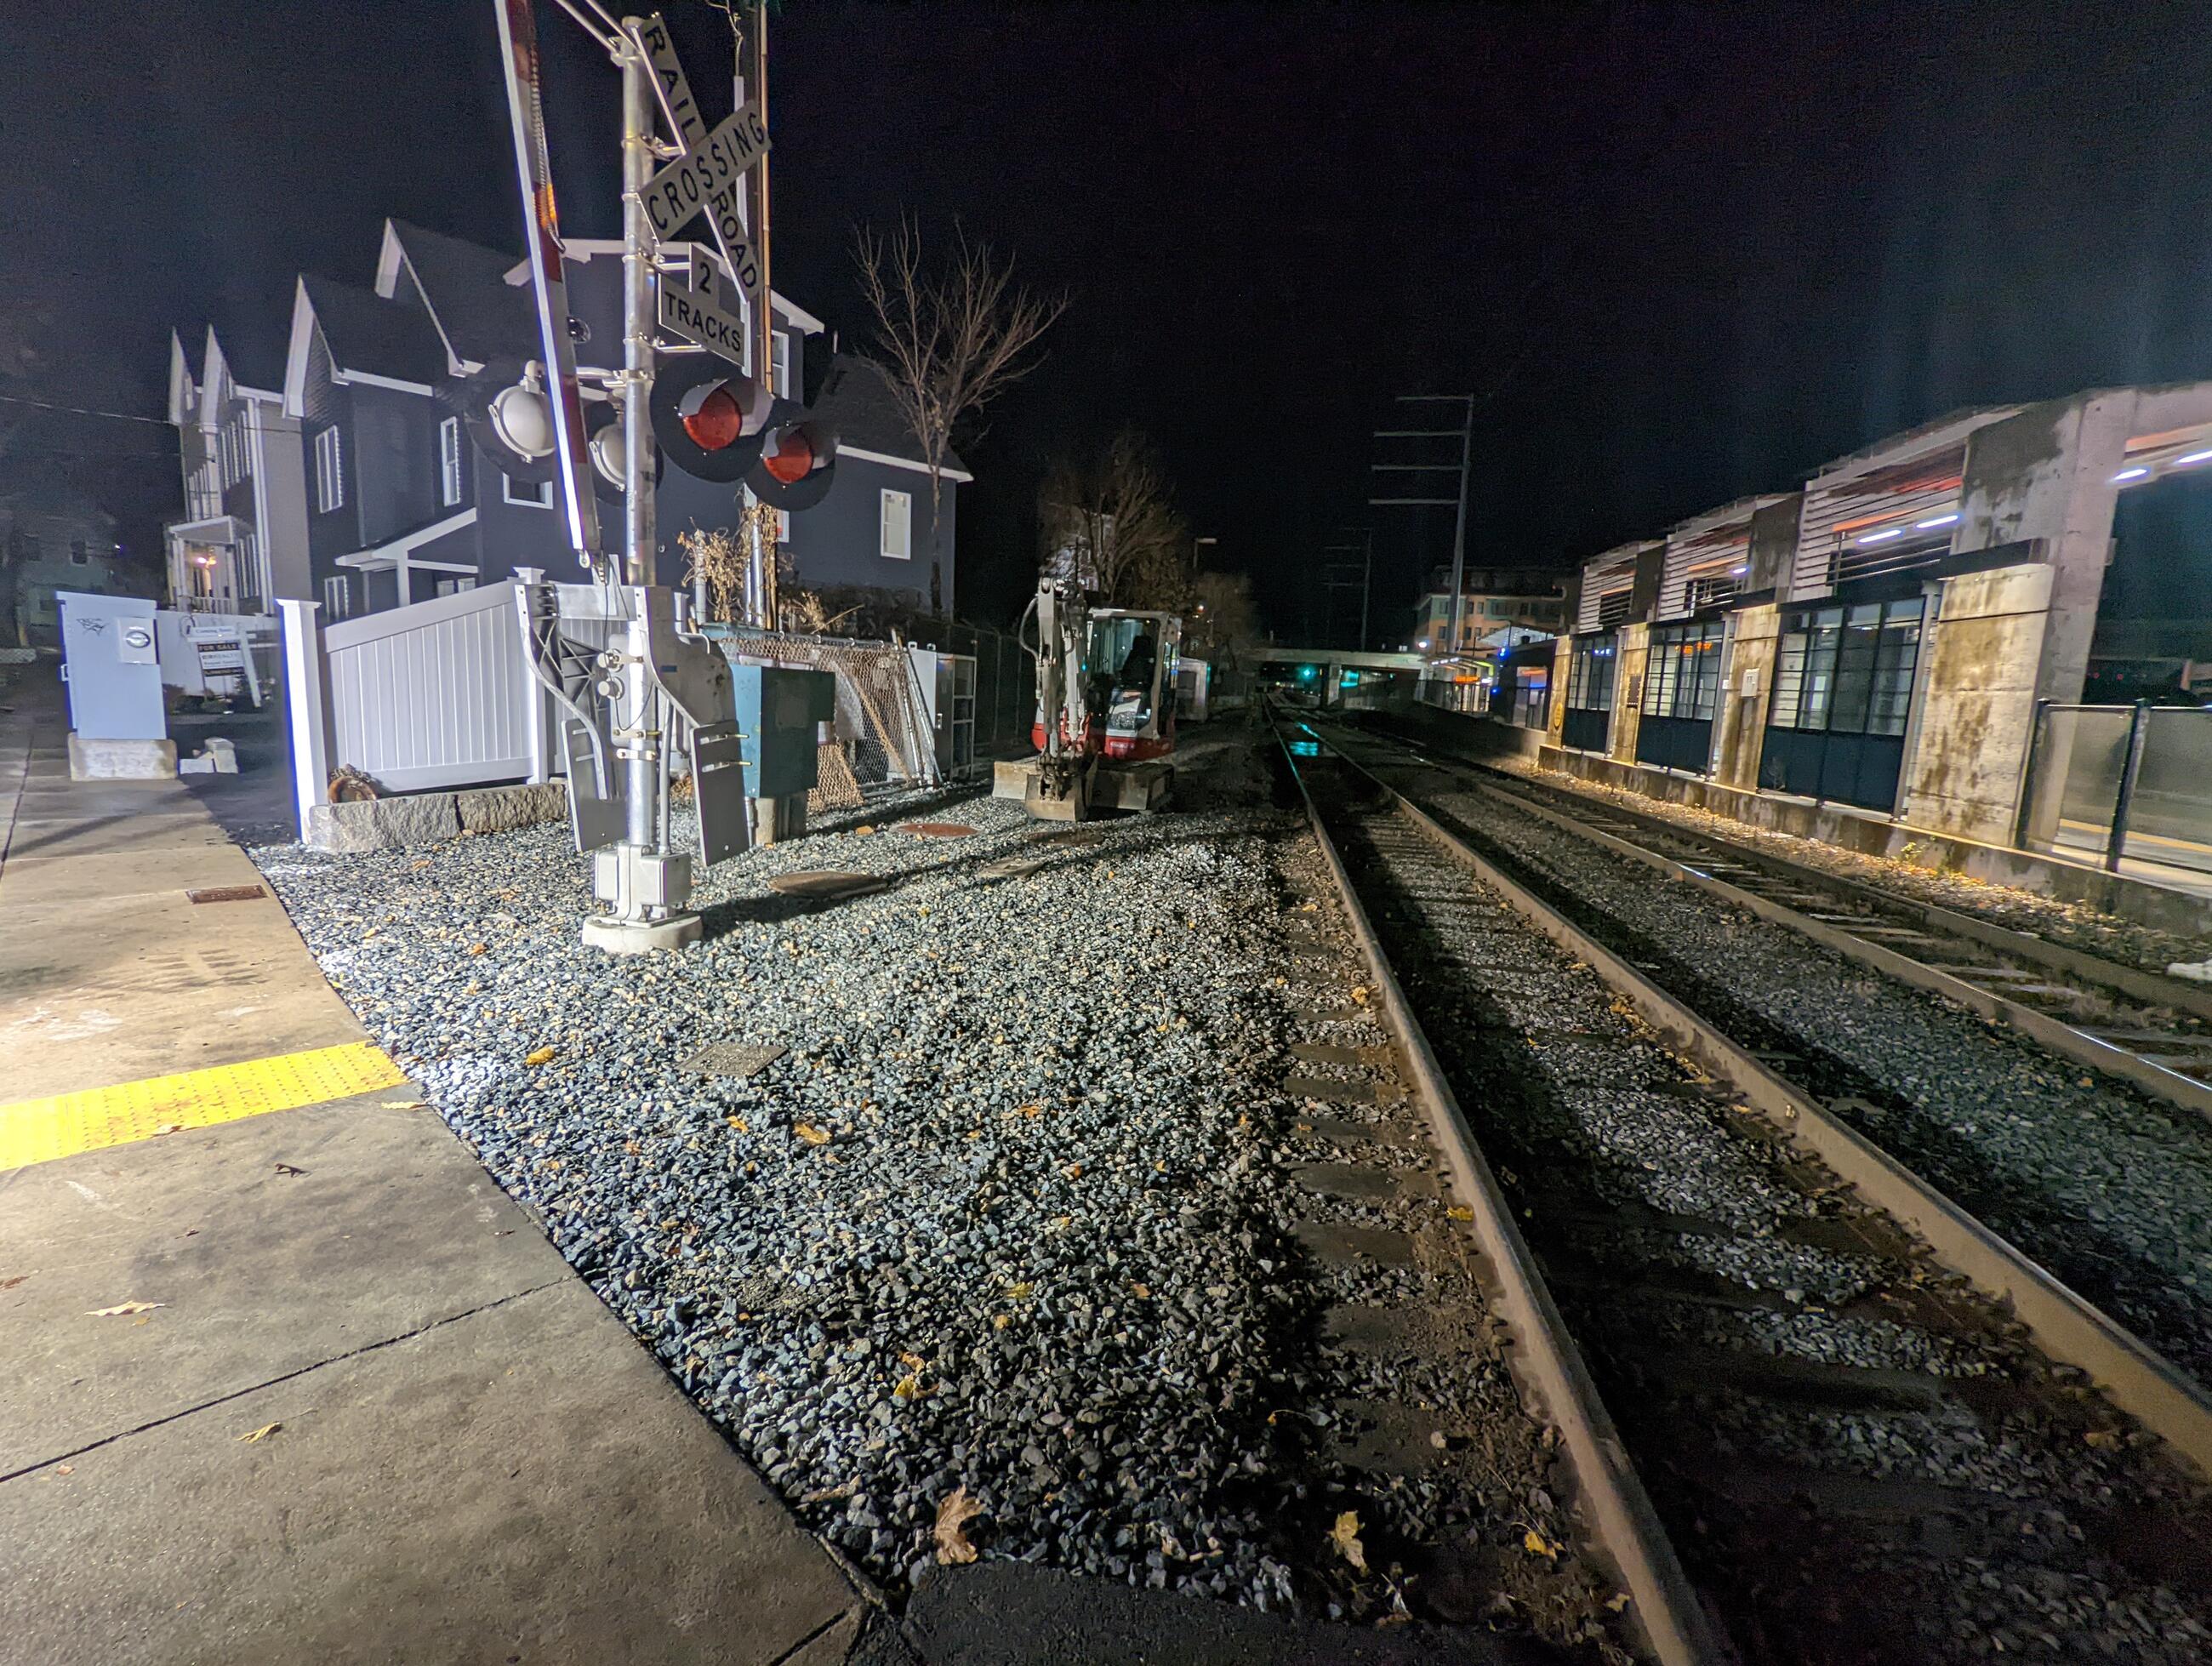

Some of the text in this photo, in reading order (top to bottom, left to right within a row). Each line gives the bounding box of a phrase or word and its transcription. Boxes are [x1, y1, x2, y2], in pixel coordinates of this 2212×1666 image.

[644, 26, 759, 290] RAIL ROAD
[647, 111, 765, 231] CROSSING
[664, 290, 742, 352] TRACKS
[698, 262, 712, 295] 2
